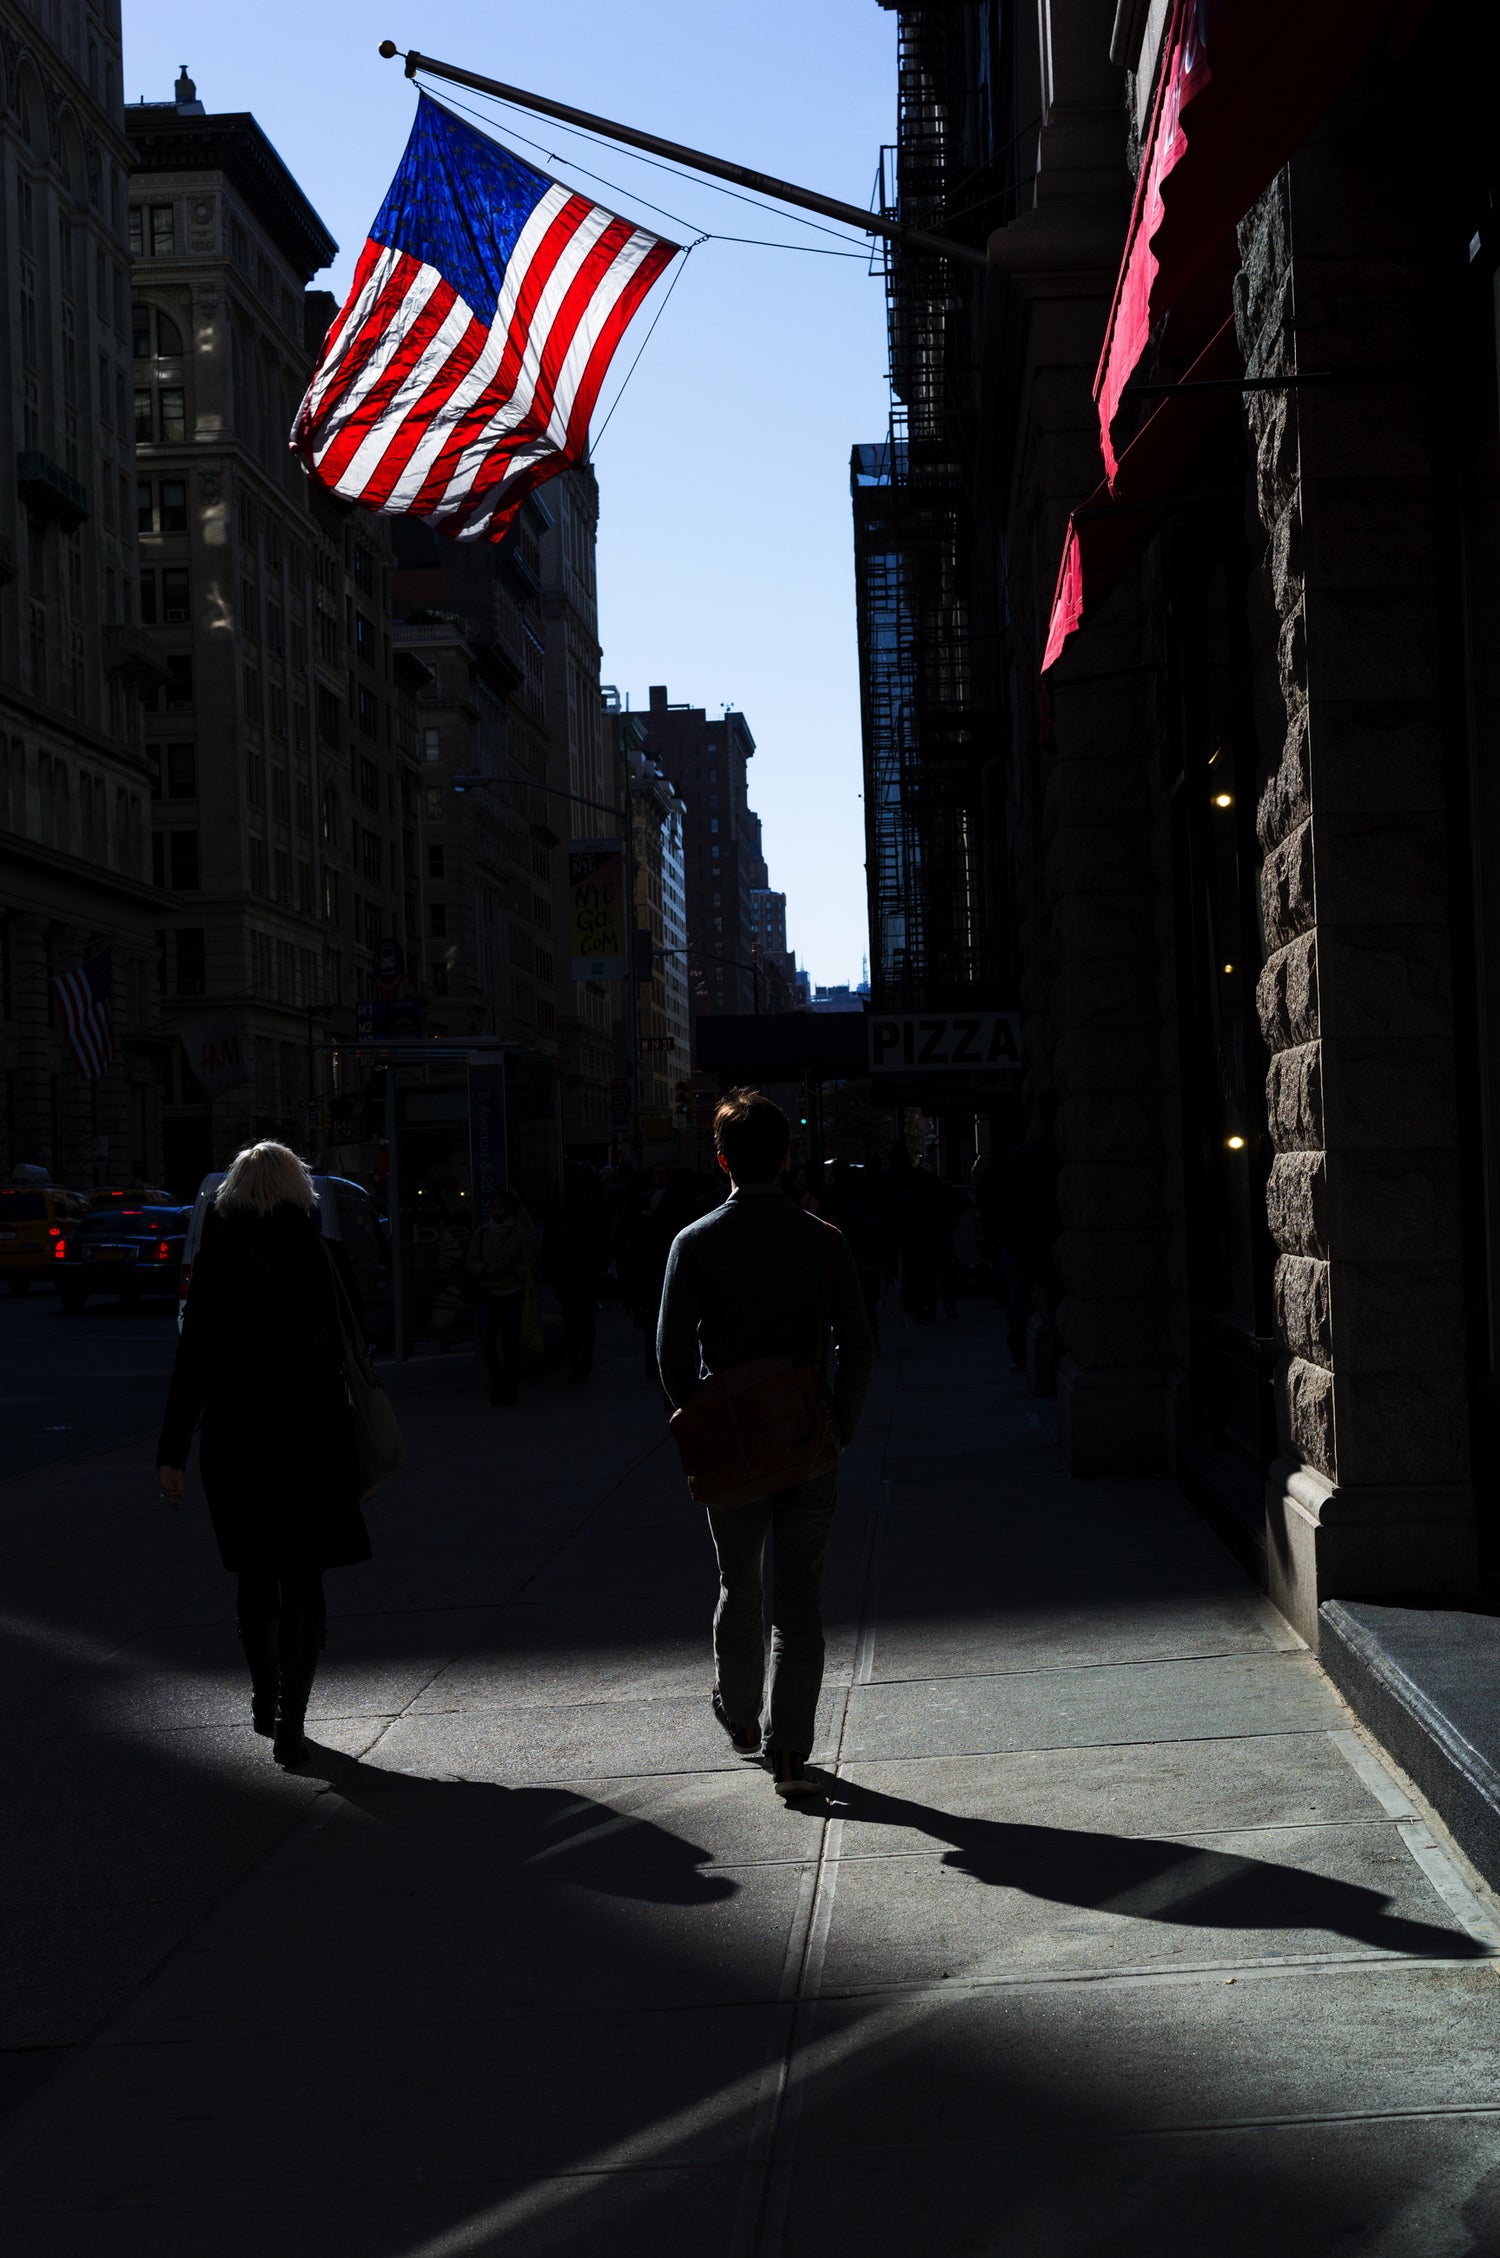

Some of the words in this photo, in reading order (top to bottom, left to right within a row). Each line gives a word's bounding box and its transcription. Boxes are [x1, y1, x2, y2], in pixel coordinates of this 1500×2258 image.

[575, 883, 615, 908] NYC
[358, 1021, 373, 1033] M2
[652, 1039, 660, 1050] 19
[873, 1018, 1022, 1064] PIZZA
